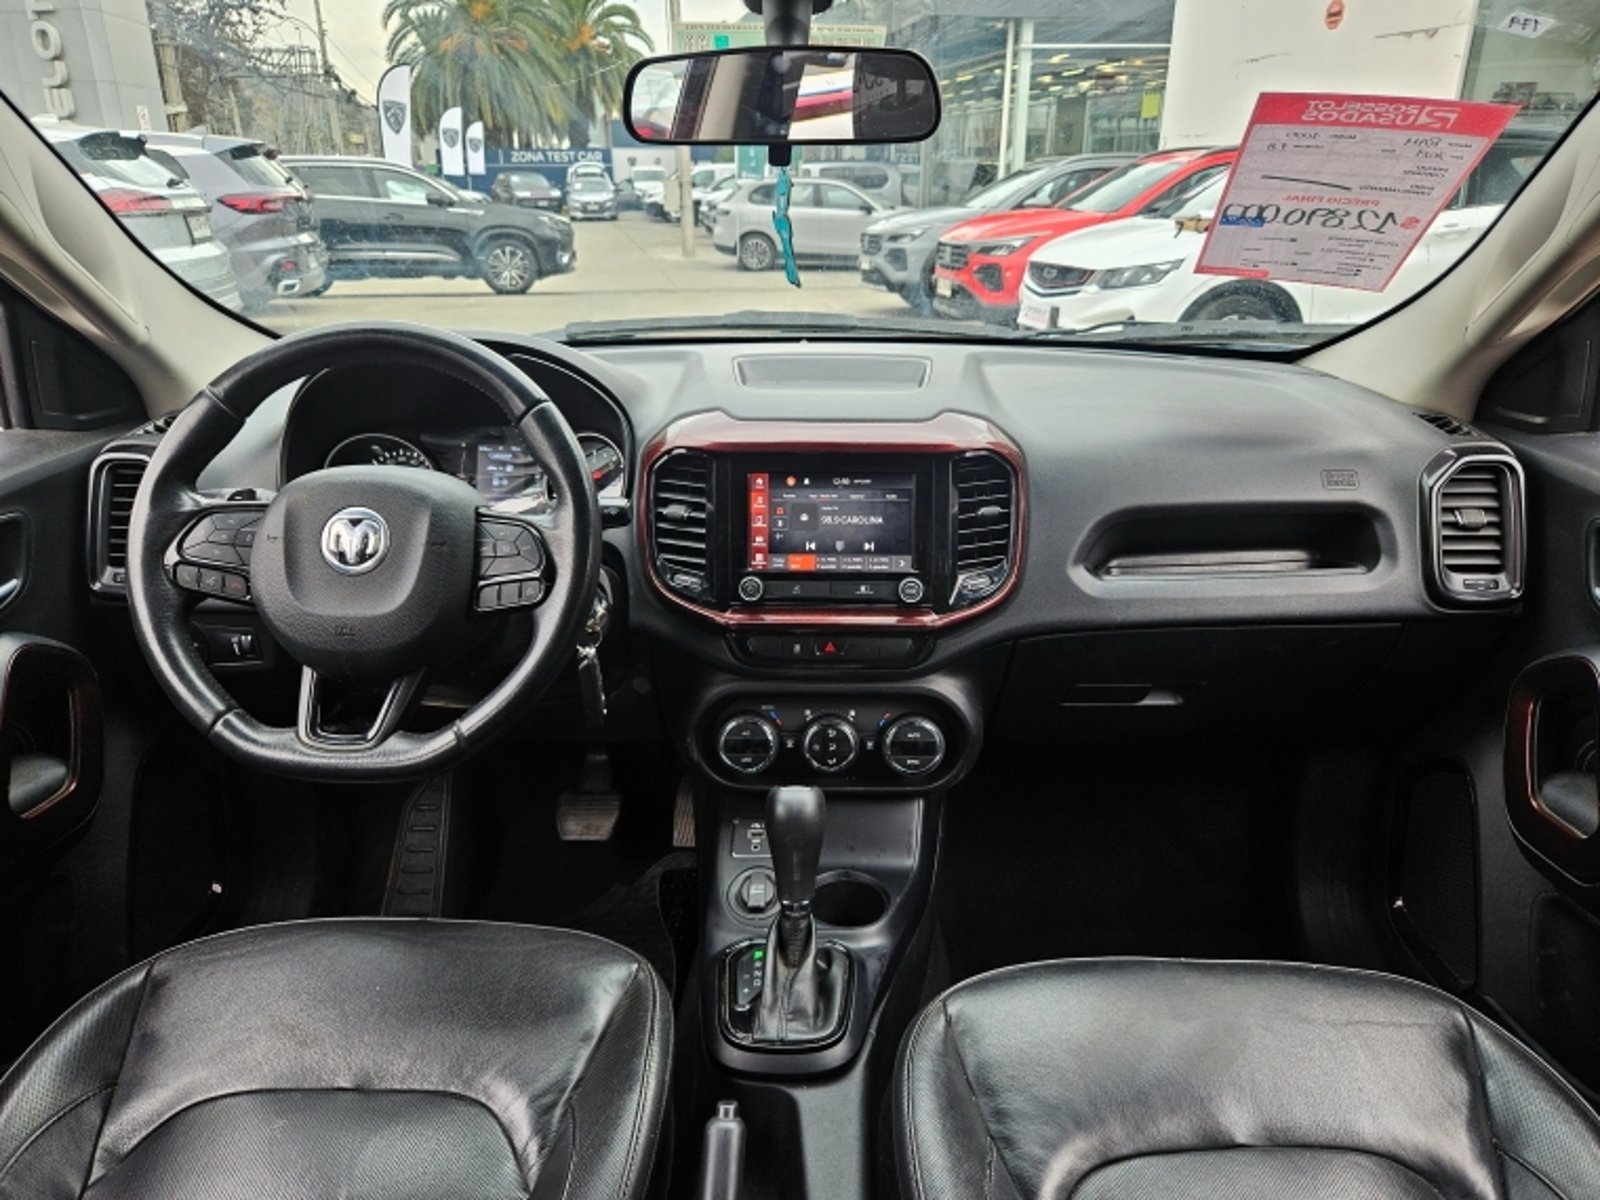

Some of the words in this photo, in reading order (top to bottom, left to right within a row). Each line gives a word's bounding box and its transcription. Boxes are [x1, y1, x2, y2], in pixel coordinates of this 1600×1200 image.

[511, 150, 545, 162] ZONA
[546, 150, 575, 162] TEST
[577, 150, 603, 162] CAR
[841, 515, 884, 525] CAROLINA
